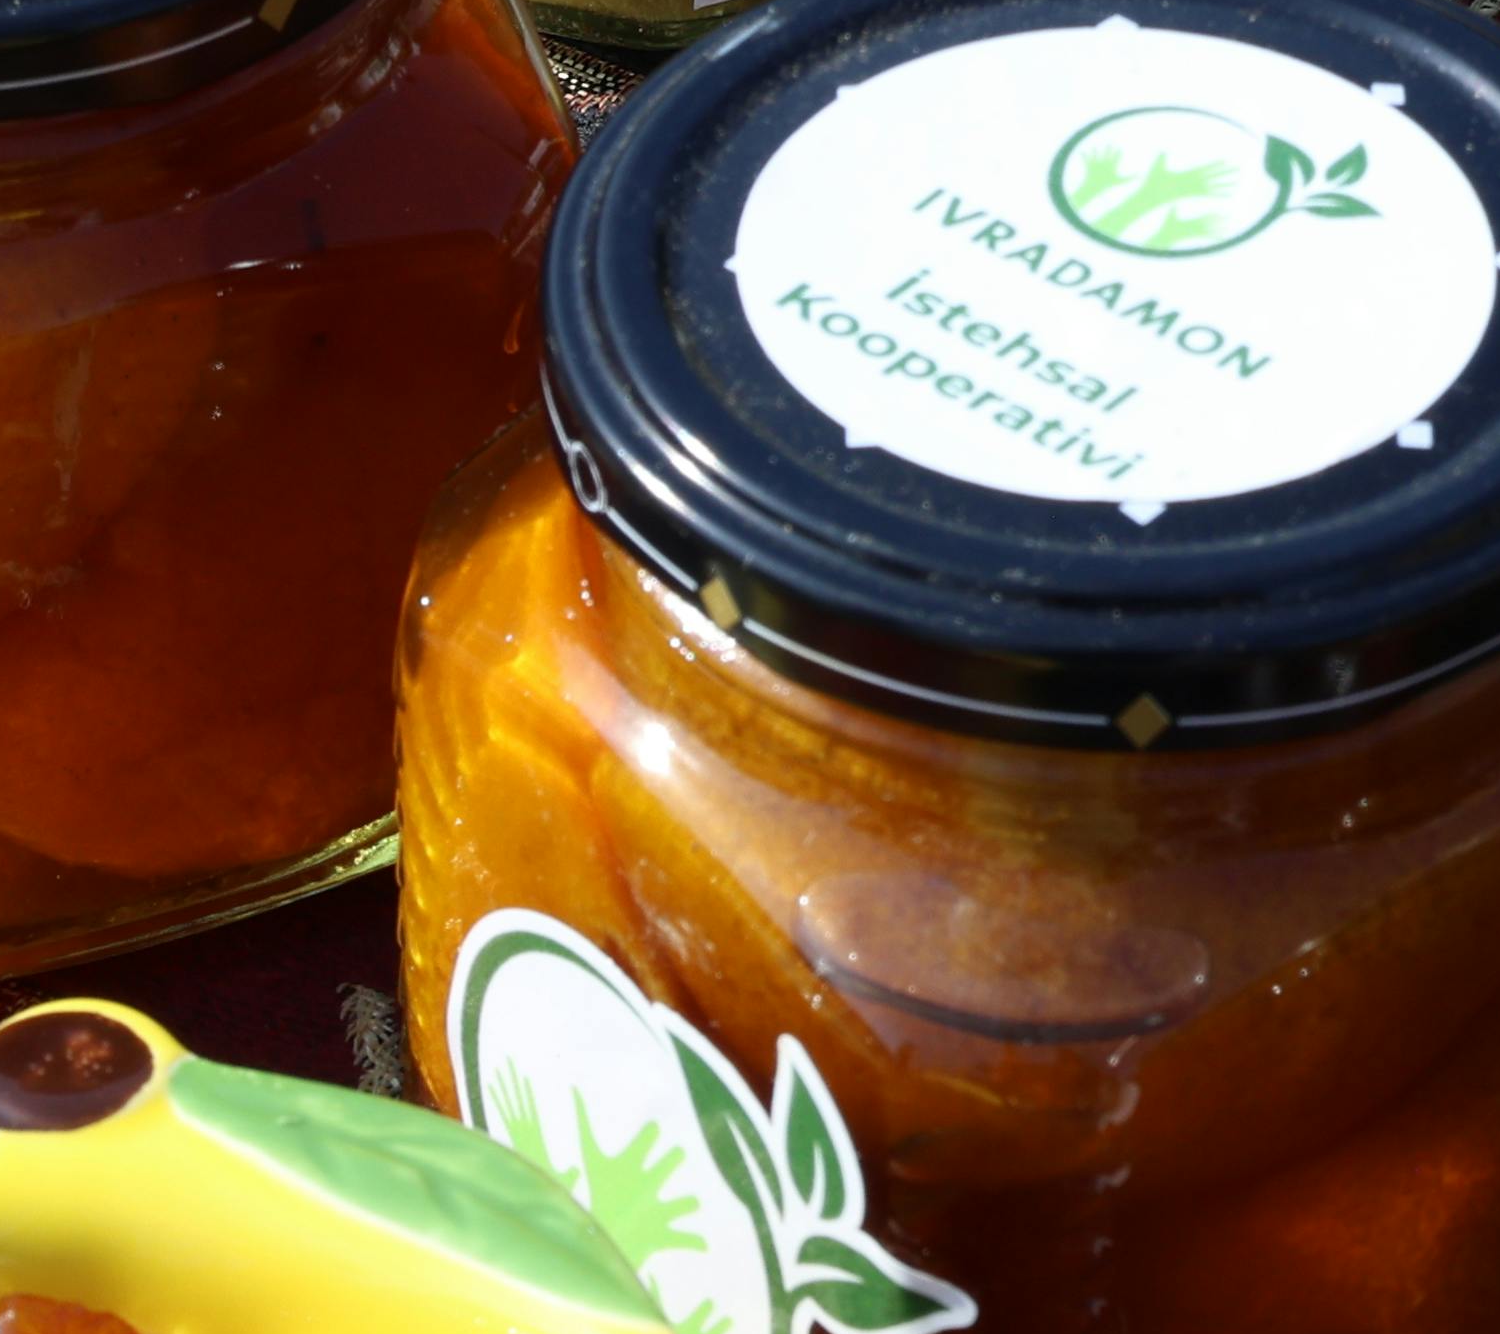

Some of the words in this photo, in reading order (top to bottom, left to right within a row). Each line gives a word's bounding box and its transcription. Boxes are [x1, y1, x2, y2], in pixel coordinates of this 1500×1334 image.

[886, 267, 1138, 415] İstehsal
[912, 187, 1272, 381] IVRADAMON
[774, 283, 1150, 483] Kooperativi
